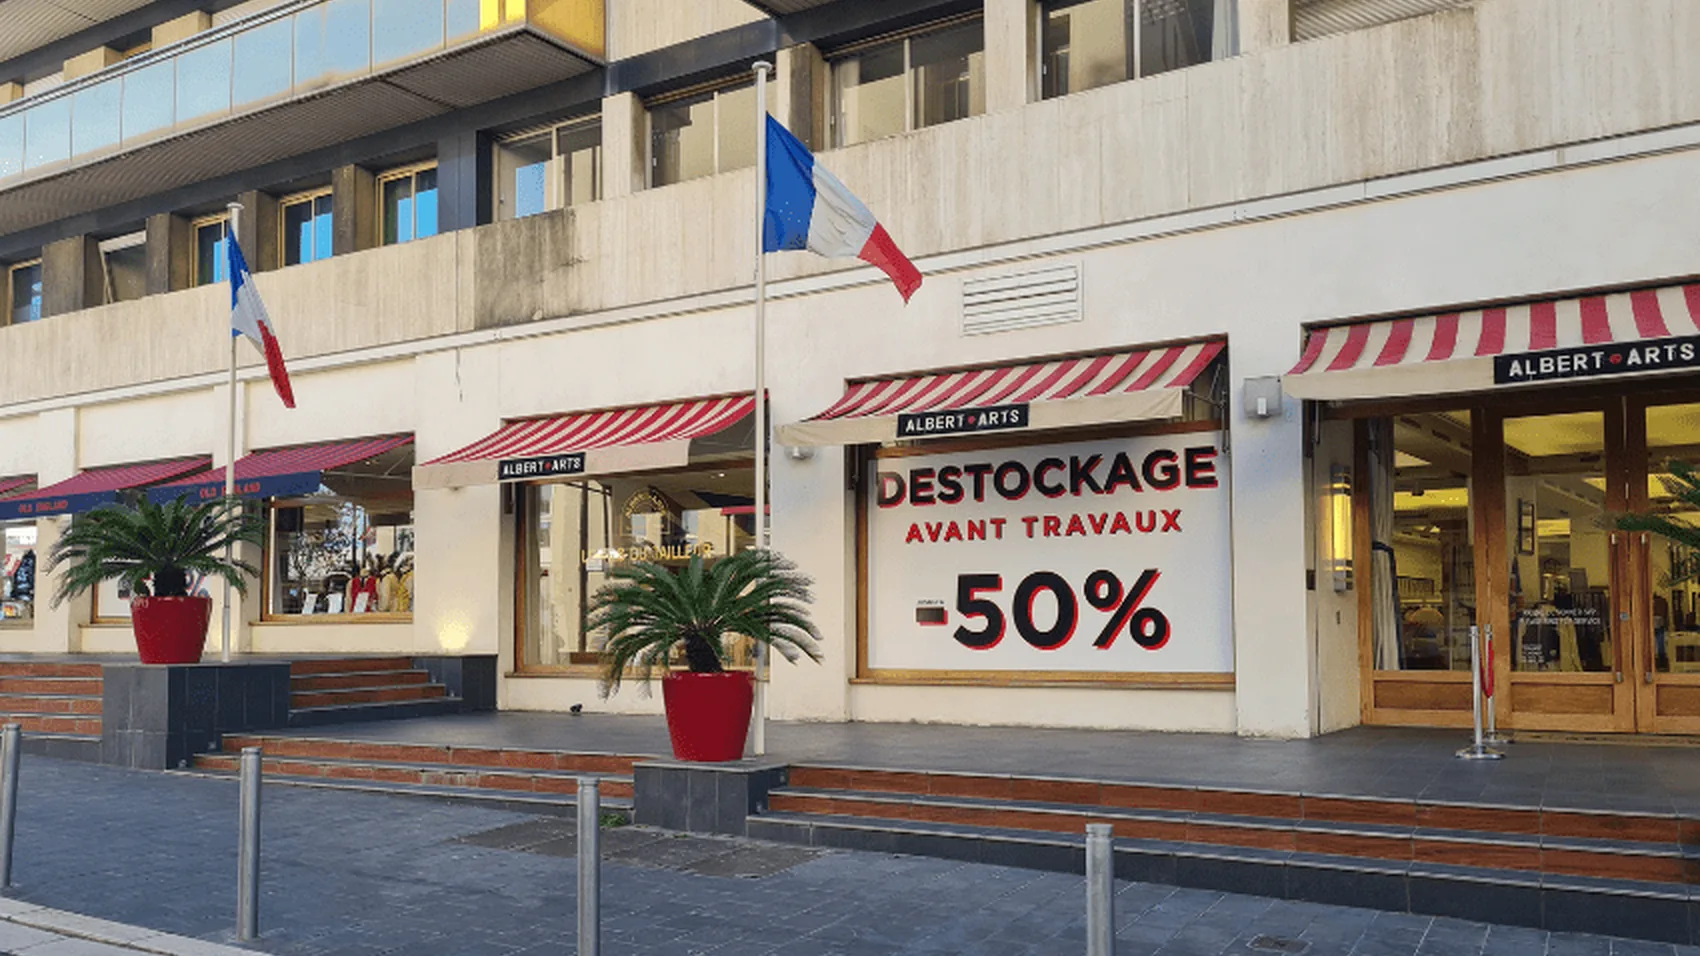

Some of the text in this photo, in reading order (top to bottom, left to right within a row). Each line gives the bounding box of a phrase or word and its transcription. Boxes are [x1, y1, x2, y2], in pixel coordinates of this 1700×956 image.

[1509, 343, 1695, 377] ALBERT ARTS
[905, 409, 1020, 433] ALBERT ARTS
[503, 457, 581, 475] ALBERT ARTS
[877, 446, 1218, 507] DESTOCKAGE
[905, 508, 1183, 543] AVANT TRAVAUX
[654, 543, 713, 560] TAILLEUR
[915, 568, 1171, 651] -50%
